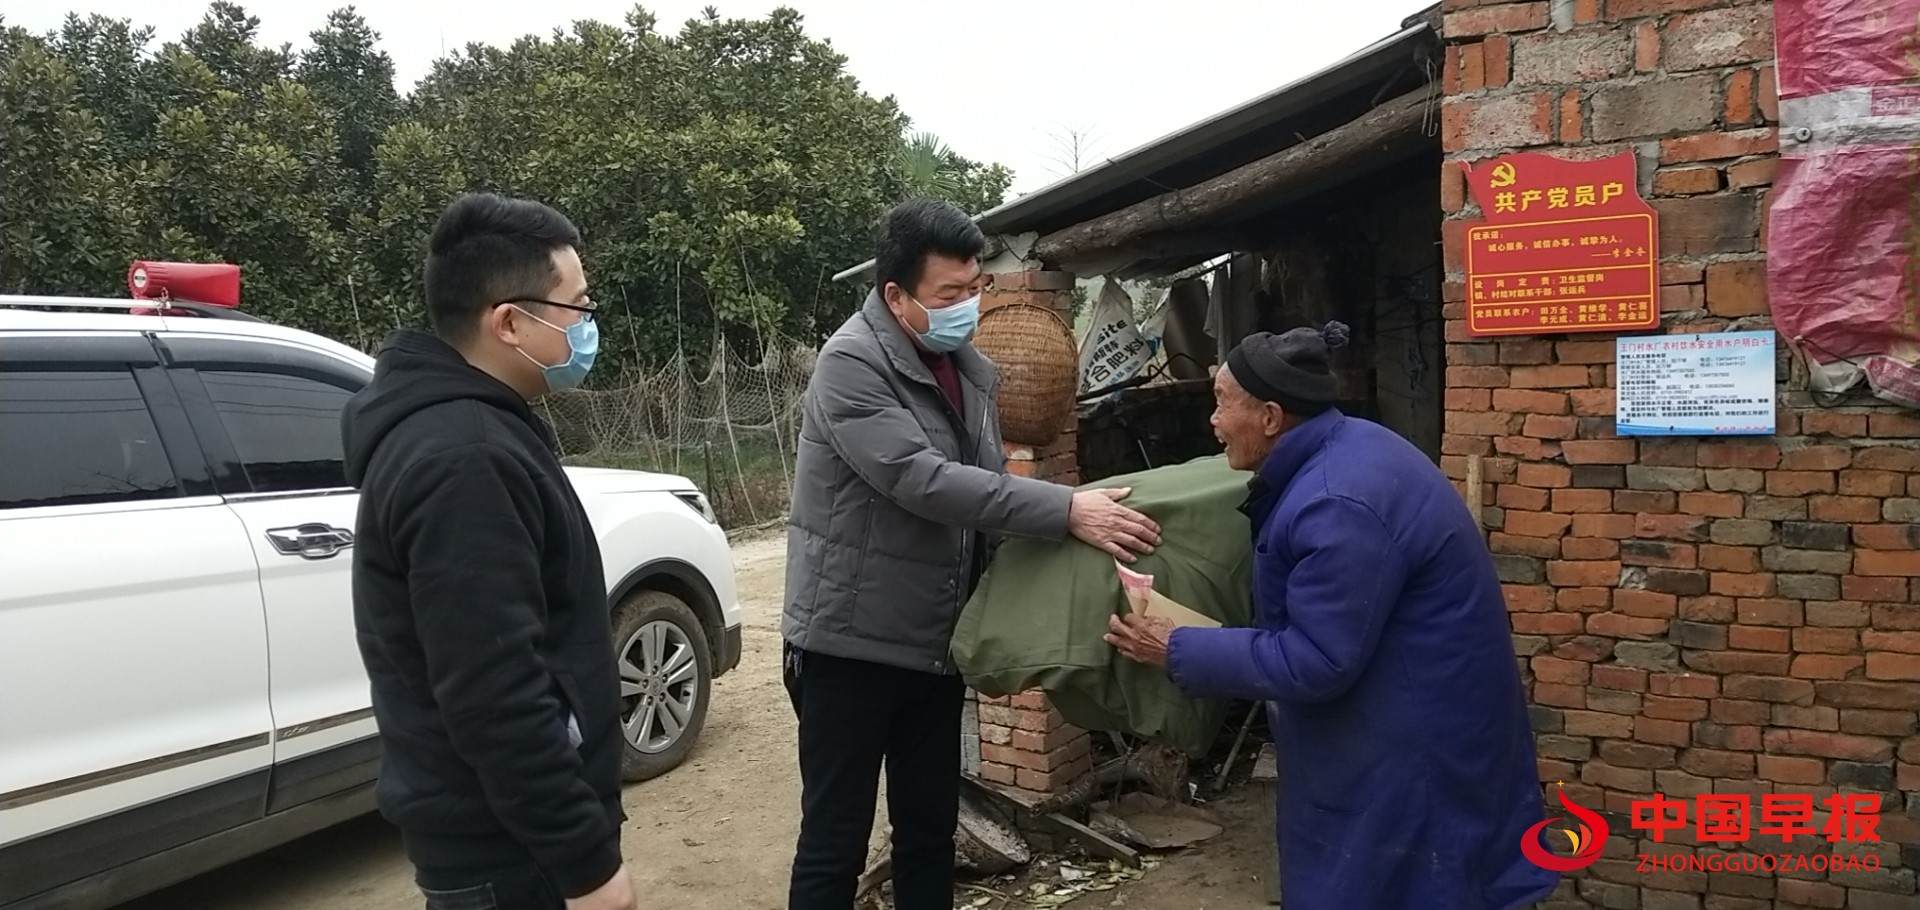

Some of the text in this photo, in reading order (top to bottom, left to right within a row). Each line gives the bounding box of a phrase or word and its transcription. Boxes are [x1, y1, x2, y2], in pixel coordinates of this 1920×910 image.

[1495, 182, 1623, 214] 共产党员户
